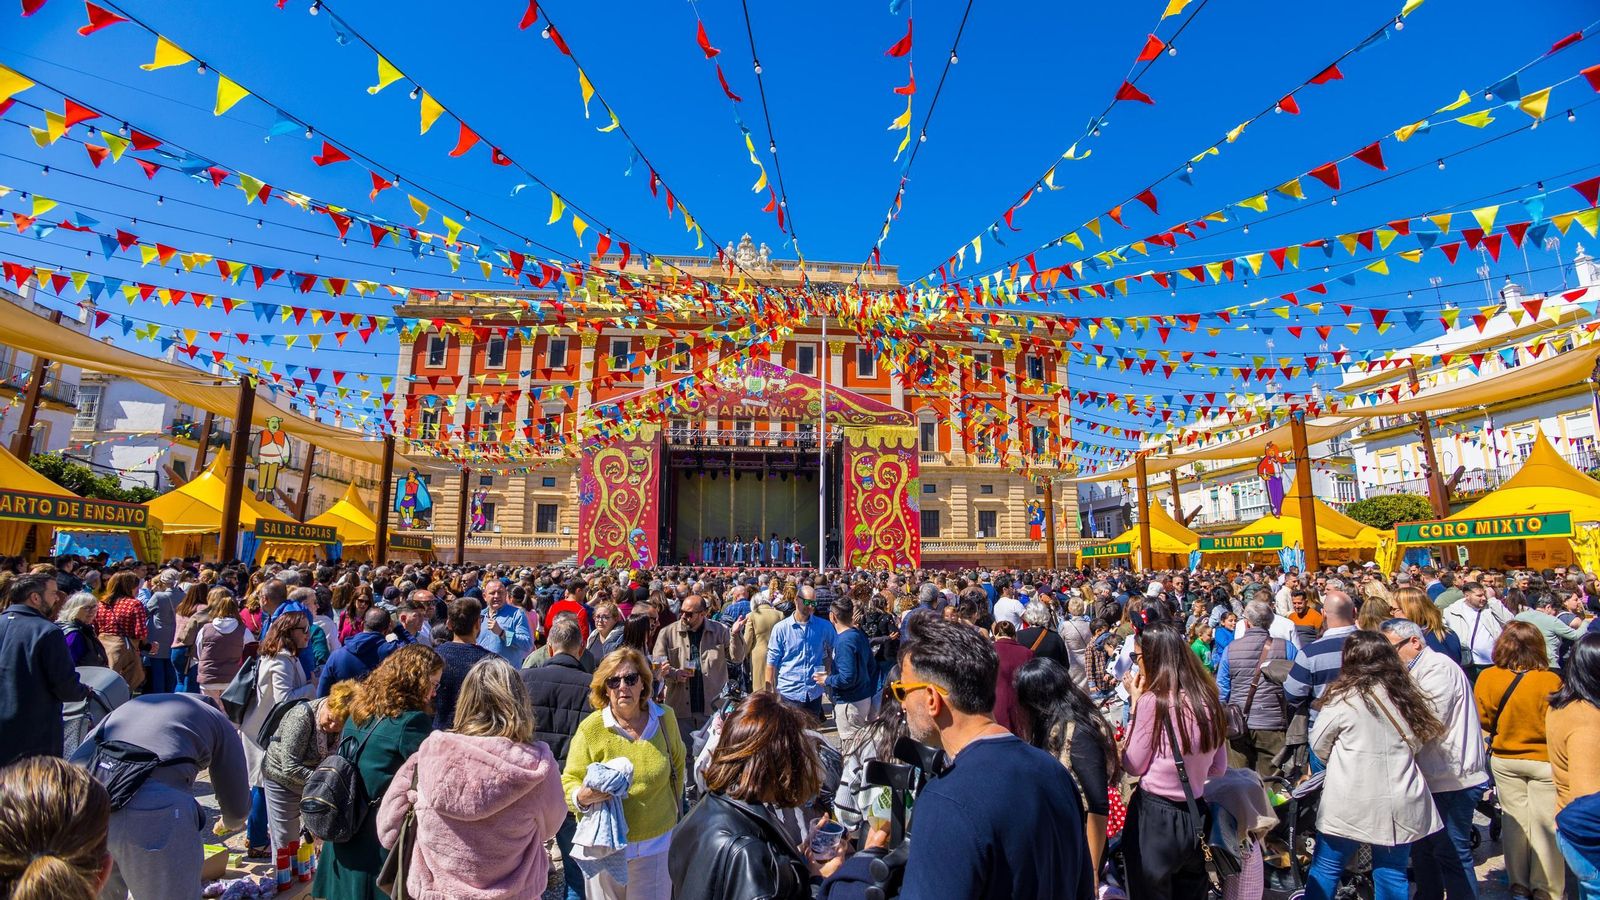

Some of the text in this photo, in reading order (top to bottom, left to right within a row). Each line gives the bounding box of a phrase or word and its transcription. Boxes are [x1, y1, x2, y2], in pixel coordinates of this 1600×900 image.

[707, 404, 801, 418] CARNAVAL
[57, 501, 79, 518] DE
[84, 503, 145, 523] ENSAYO
[264, 522, 331, 539] SAL DE COPLAS
[1419, 517, 1542, 538] CORO MIXTO
[1214, 536, 1265, 548] PLUMERO
